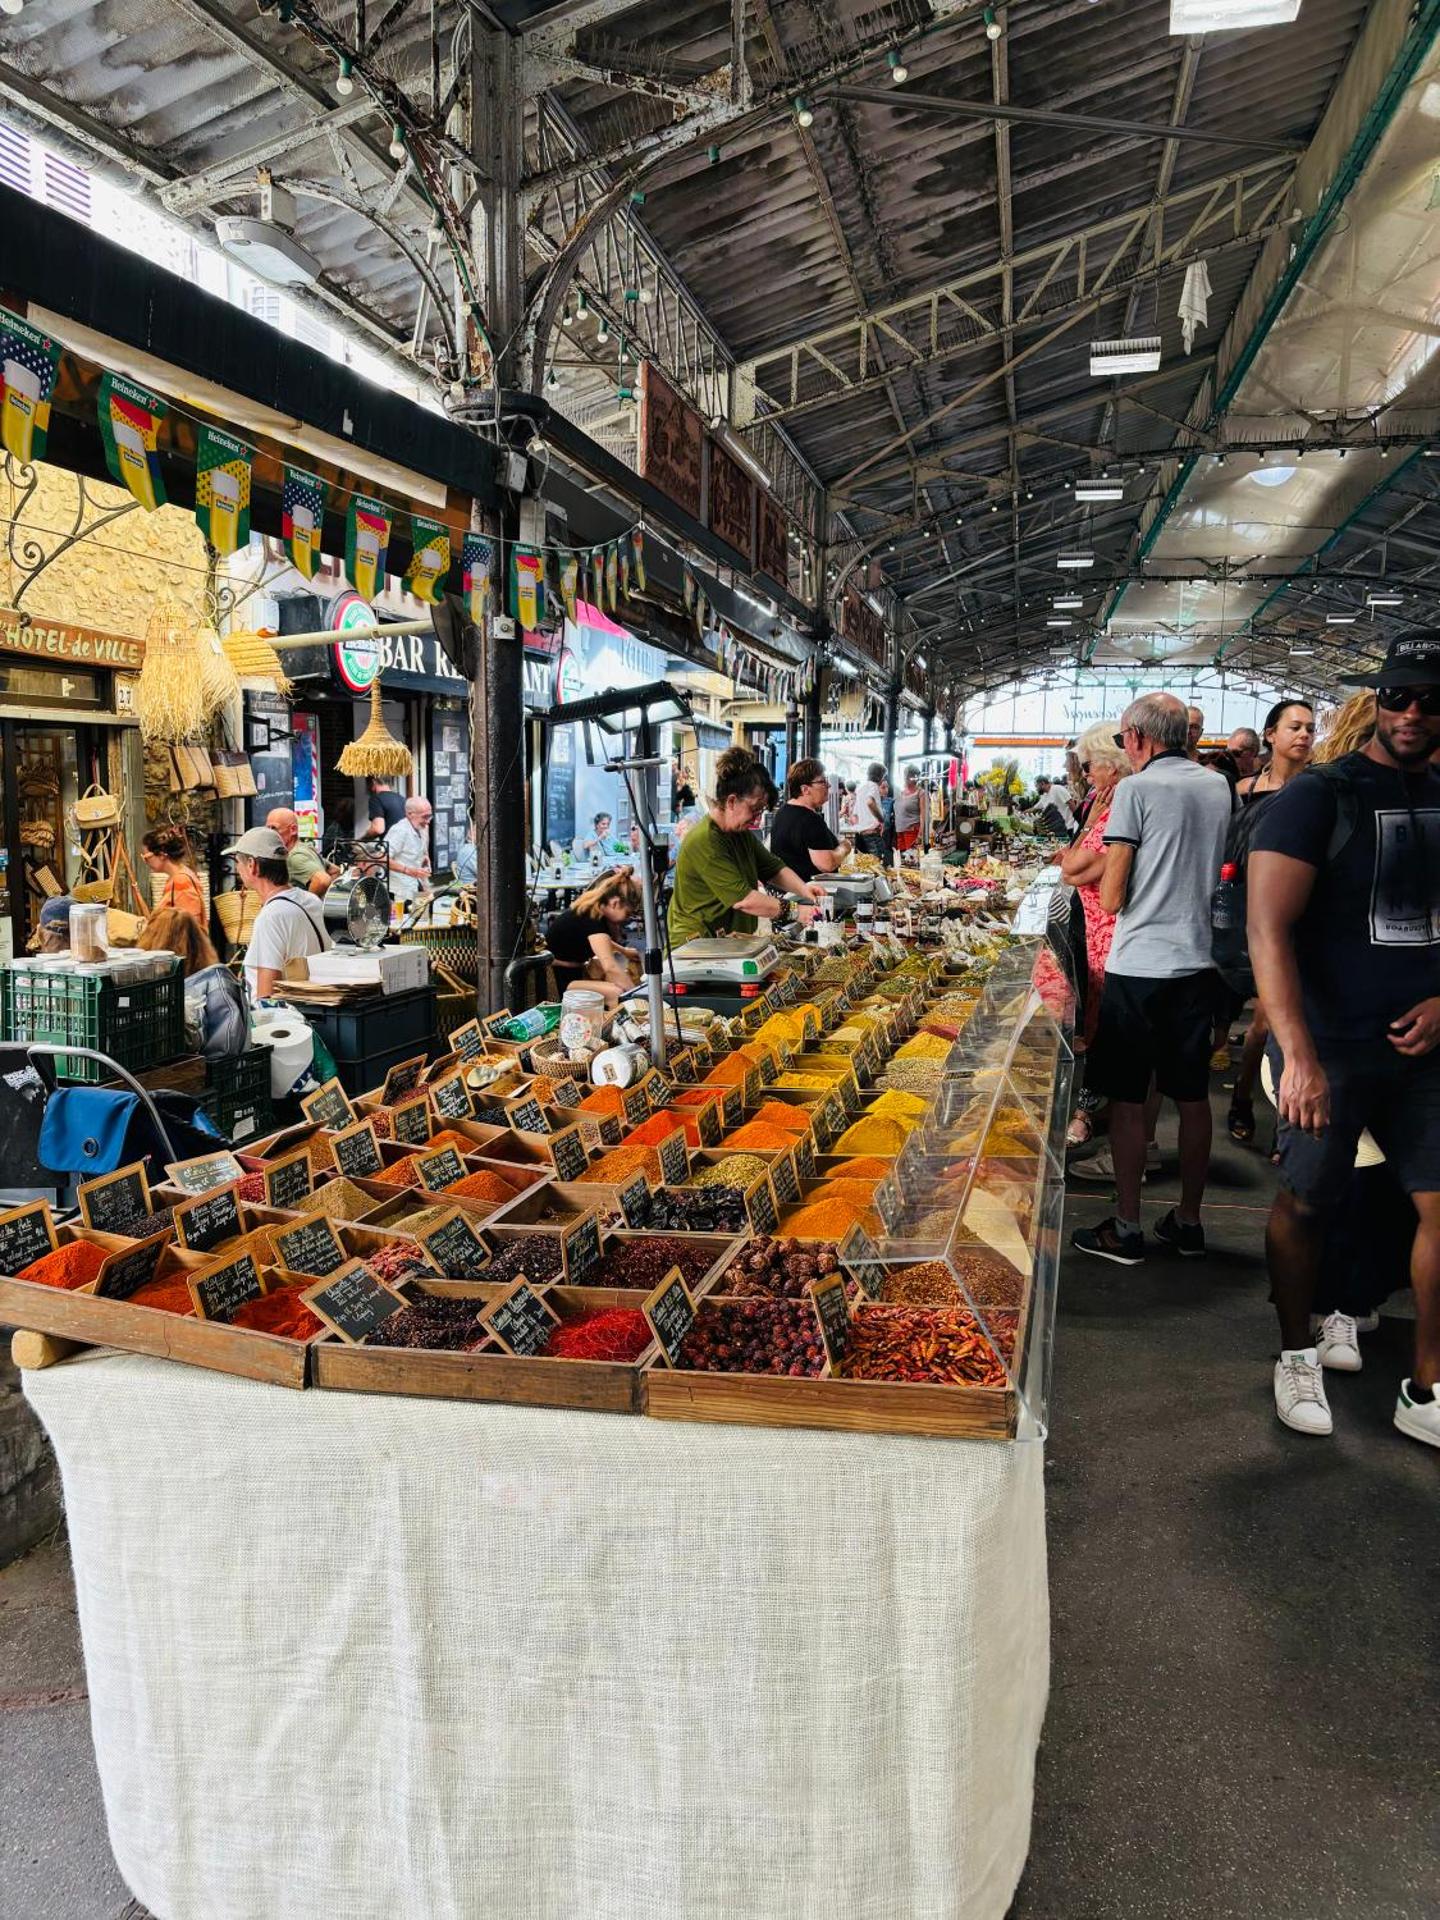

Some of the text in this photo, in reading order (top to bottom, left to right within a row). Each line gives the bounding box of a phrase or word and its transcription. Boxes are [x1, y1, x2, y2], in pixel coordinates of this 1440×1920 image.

[111, 378, 148, 406] Heineken
[207, 430, 241, 453] Heineken
[71, 632, 90, 656] de
[94, 637, 140, 664] VILLE
[380, 634, 426, 675] BAR
